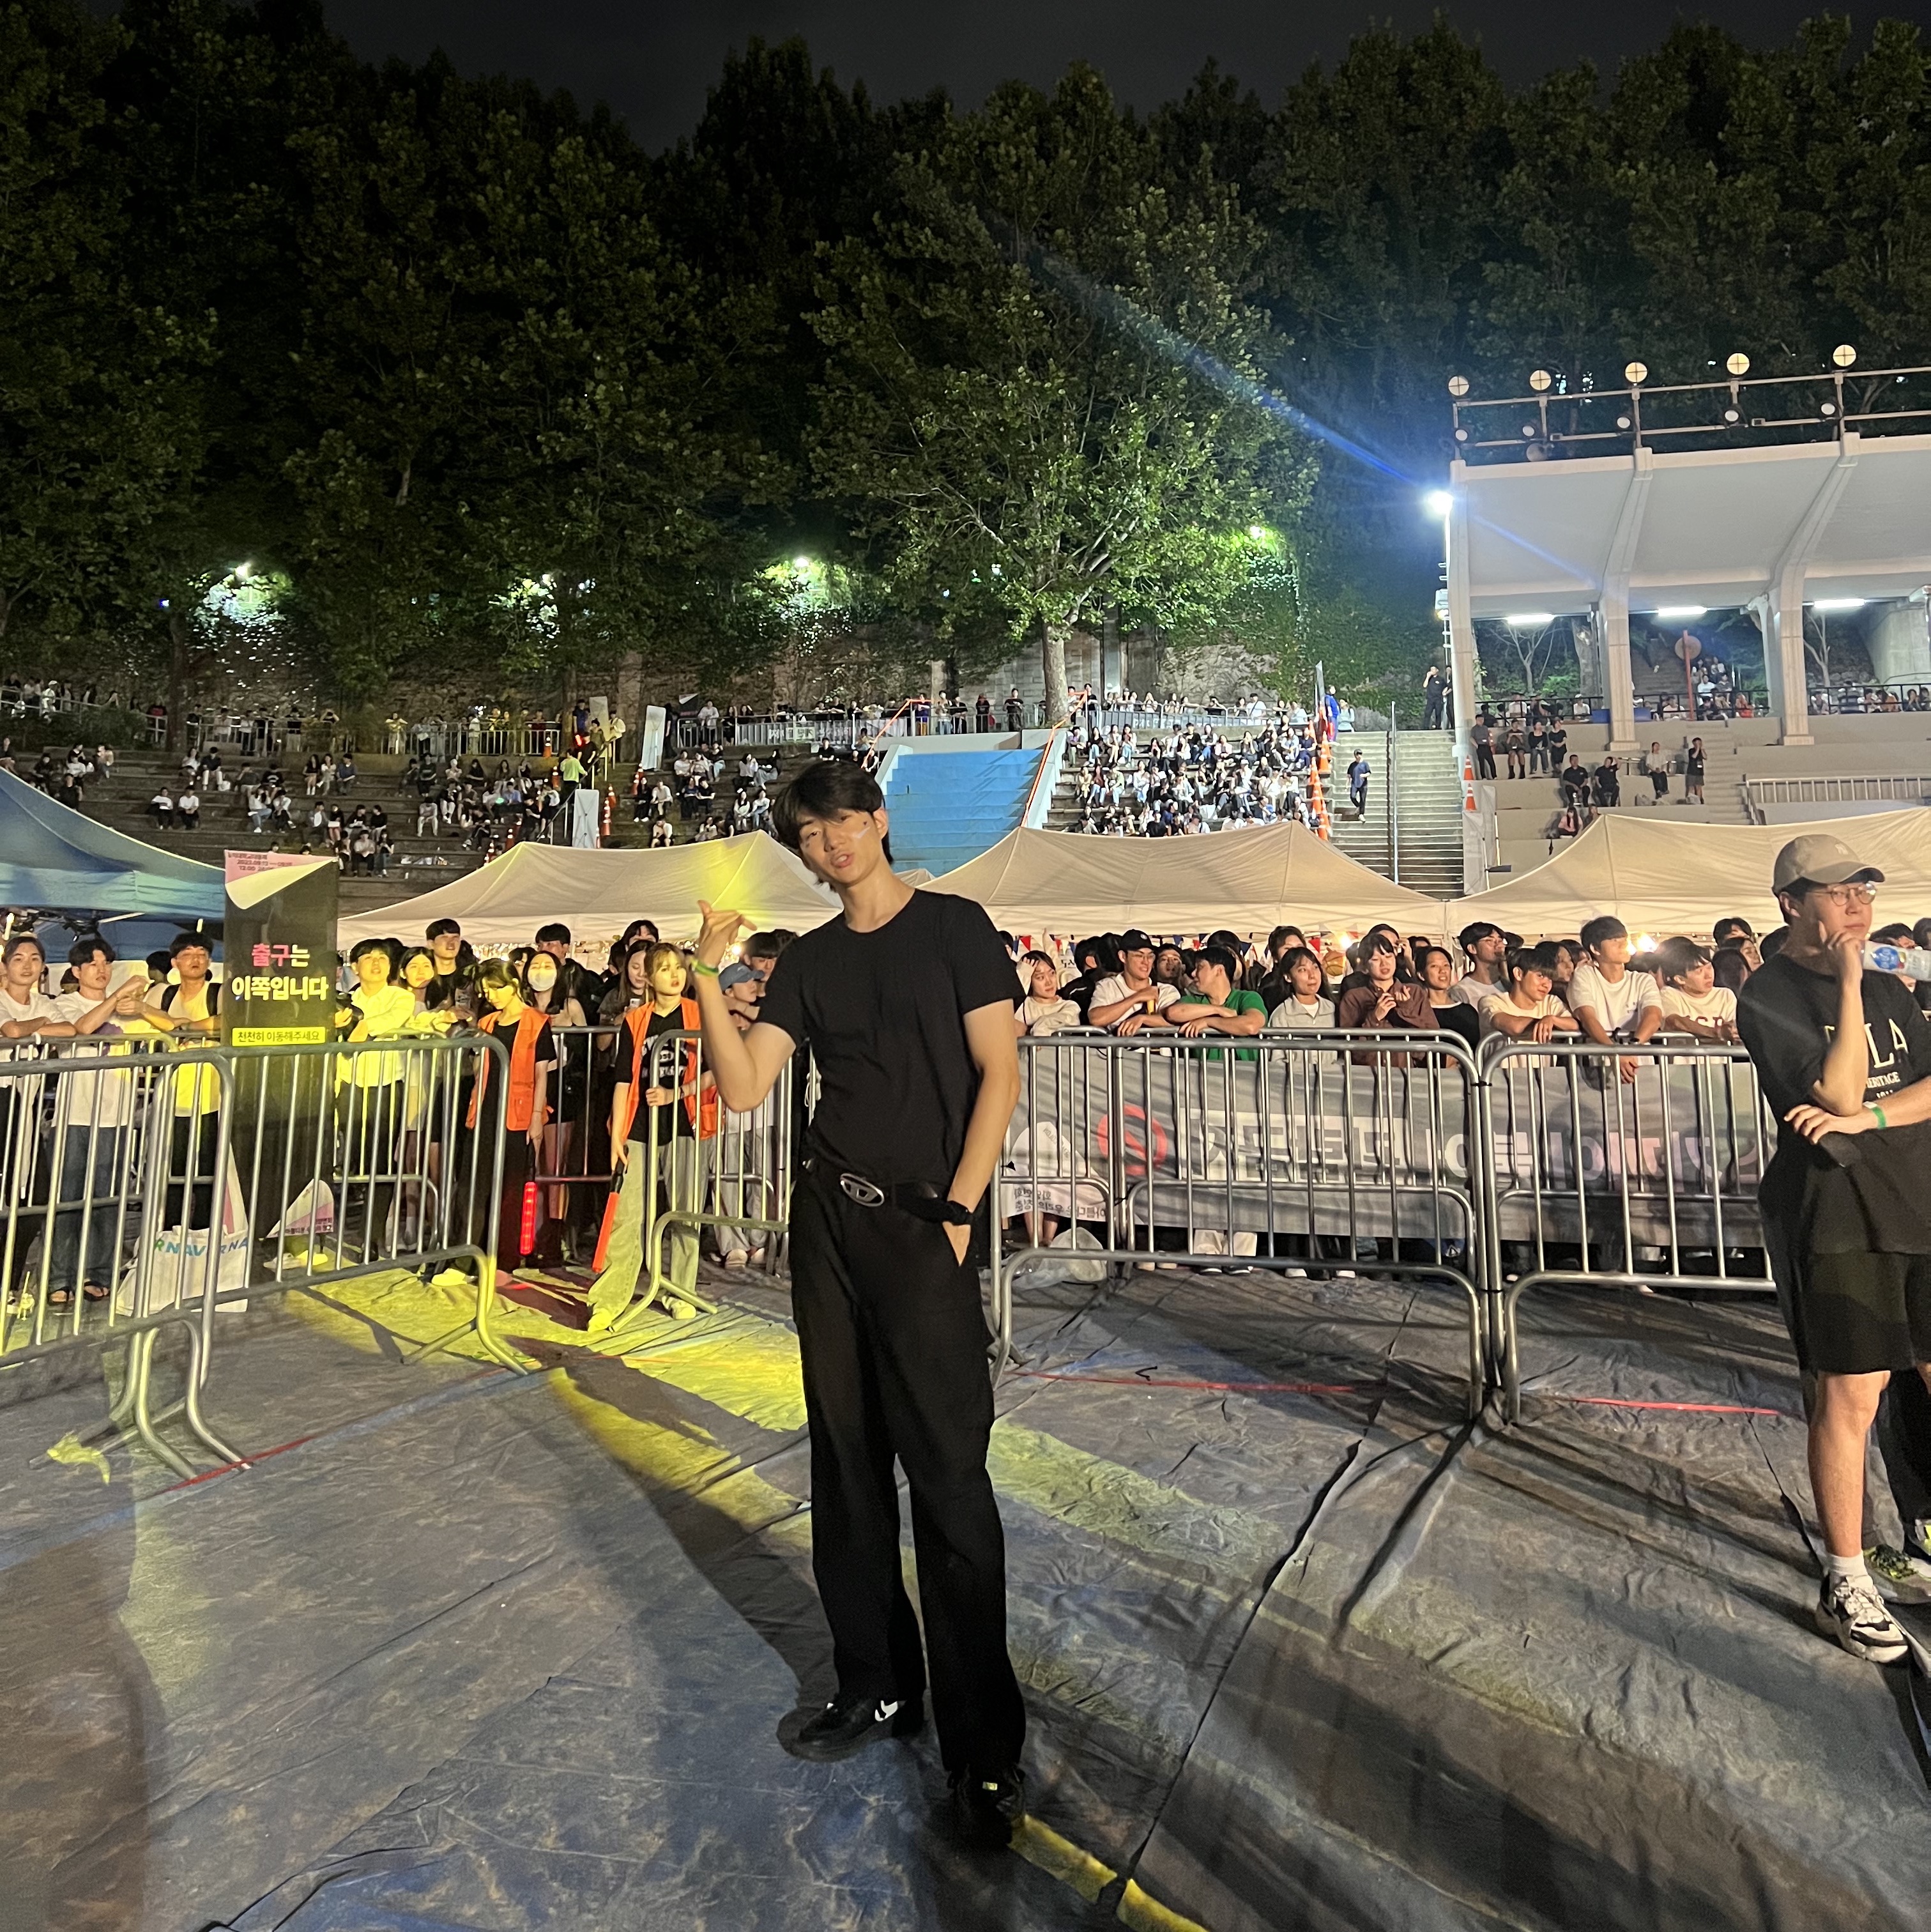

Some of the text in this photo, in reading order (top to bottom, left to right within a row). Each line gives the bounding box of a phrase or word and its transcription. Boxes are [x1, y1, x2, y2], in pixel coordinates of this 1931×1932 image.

[252, 943, 310, 967] 출구는
[231, 975, 330, 1001] 이쪽입니다
[238, 1031, 320, 1043] 천천히 이동해주세요
